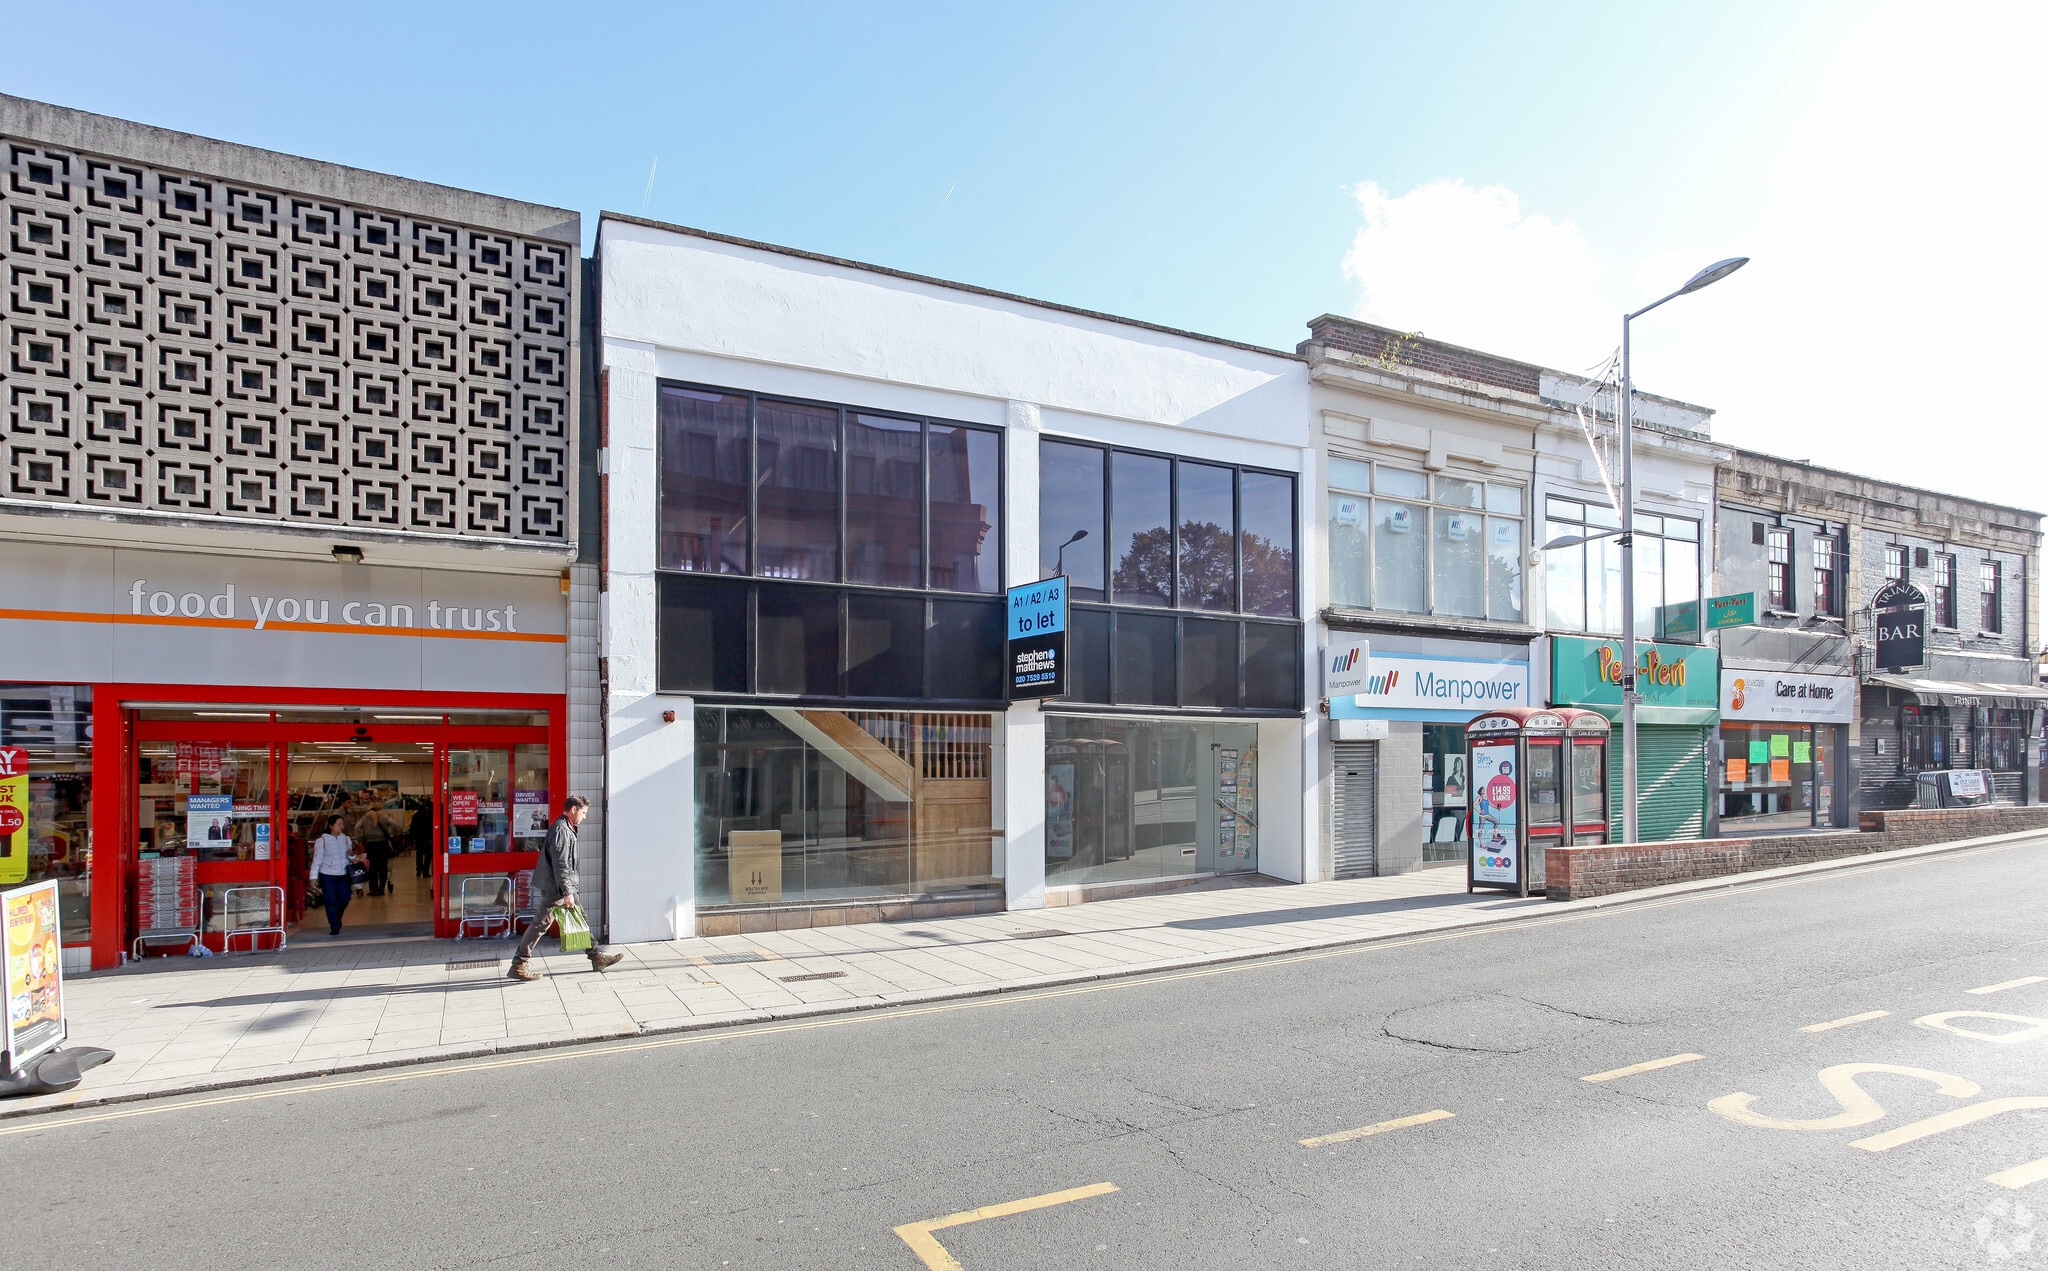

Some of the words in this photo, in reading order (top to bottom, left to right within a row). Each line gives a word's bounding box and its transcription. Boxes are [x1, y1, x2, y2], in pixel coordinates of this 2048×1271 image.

[1014, 596, 1023, 608] A1
[1031, 592, 1041, 605] A2
[1048, 588, 1059, 601] A3
[1878, 585, 1923, 604] TRINITY
[128, 579, 235, 619] food
[249, 596, 329, 630] you
[341, 601, 413, 628] can
[427, 600, 518, 632] trust
[1019, 616, 1032, 632] to
[1037, 610, 1055, 629] let
[1879, 624, 1922, 641] BAR
[1017, 649, 1048, 664] stephen
[1016, 659, 1055, 673] matthews
[1598, 646, 1686, 686] Pei-Peri
[1015, 675, 1026, 683] 020
[1026, 673, 1040, 682] 7529
[1041, 671, 1055, 680] 5510
[1329, 678, 1362, 690] Manpower
[1415, 671, 1520, 704] Manpower
[1776, 680, 1796, 697] Care
[1798, 682, 1808, 698] at
[1809, 683, 1834, 699] Home
[1954, 695, 1981, 707] TRINITY
[1477, 755, 1491, 764] gym
[1535, 768, 1548, 778] BT
[1492, 786, 1511, 795] £14.99
